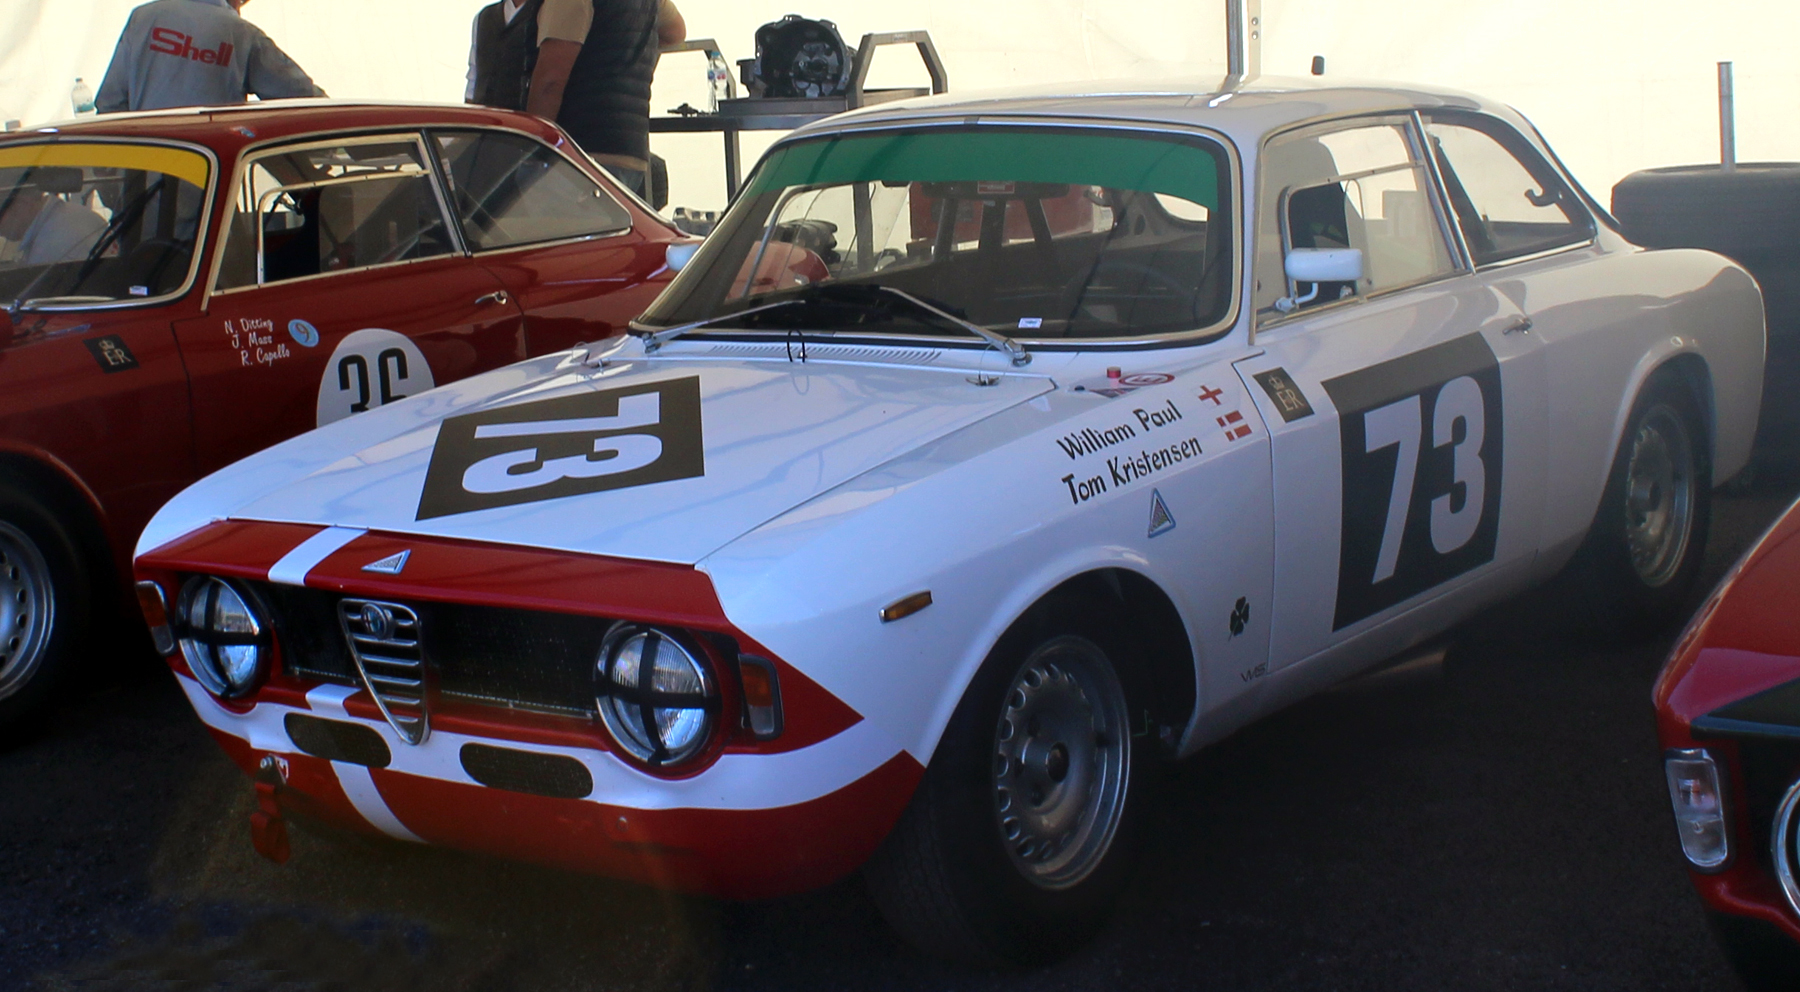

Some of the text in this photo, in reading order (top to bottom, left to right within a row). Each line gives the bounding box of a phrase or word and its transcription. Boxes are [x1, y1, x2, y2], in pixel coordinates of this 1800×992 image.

[149, 26, 234, 68] Shell
[224, 319, 239, 335] N.
[231, 331, 273, 349] J. Mass
[295, 322, 310, 343] 9
[241, 342, 291, 368] R. Capello
[462, 391, 663, 493] 73
[1056, 399, 1183, 460] William Paul
[1061, 437, 1203, 505] Tom Kristensen
[1363, 375, 1486, 585] 73
